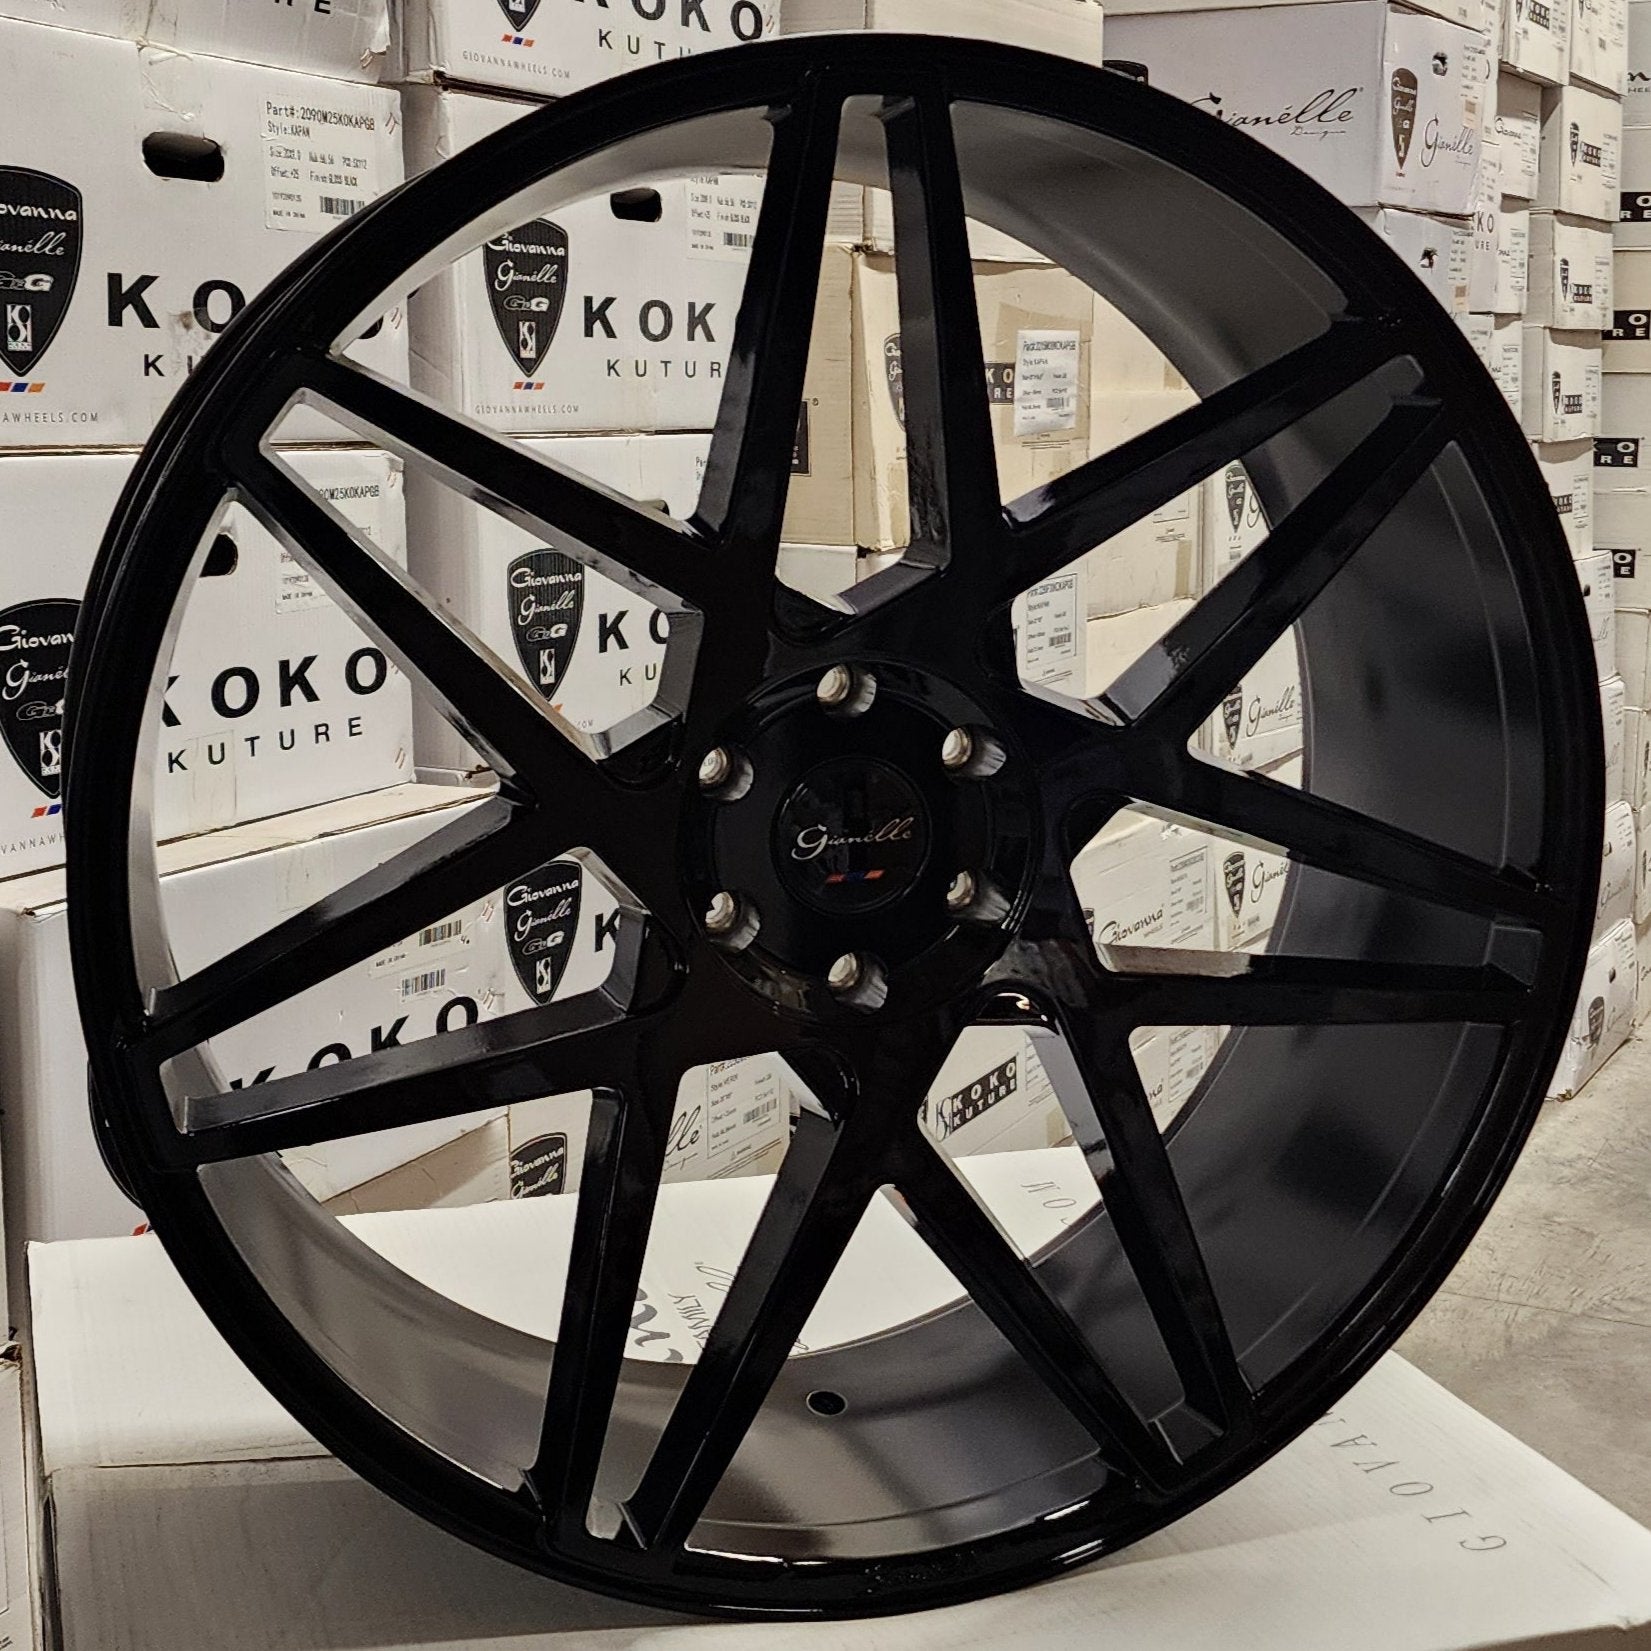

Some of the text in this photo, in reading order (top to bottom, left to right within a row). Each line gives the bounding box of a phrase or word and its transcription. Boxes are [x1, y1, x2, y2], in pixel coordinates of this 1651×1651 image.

[0, 203, 77, 221] ovanna
[107, 272, 247, 336] KO
[583, 296, 717, 343] KOK
[606, 359, 723, 379] KUTUR
[1, 411, 100, 424] AWHEELS.COM
[0, 625, 75, 651] Giovan
[597, 609, 671, 655] KO
[167, 715, 364, 774] KUTURE
[506, 879, 580, 908] Giovanna
[952, 1061, 1017, 1113] KOKO
[953, 1078, 1017, 1127] KUTURE
